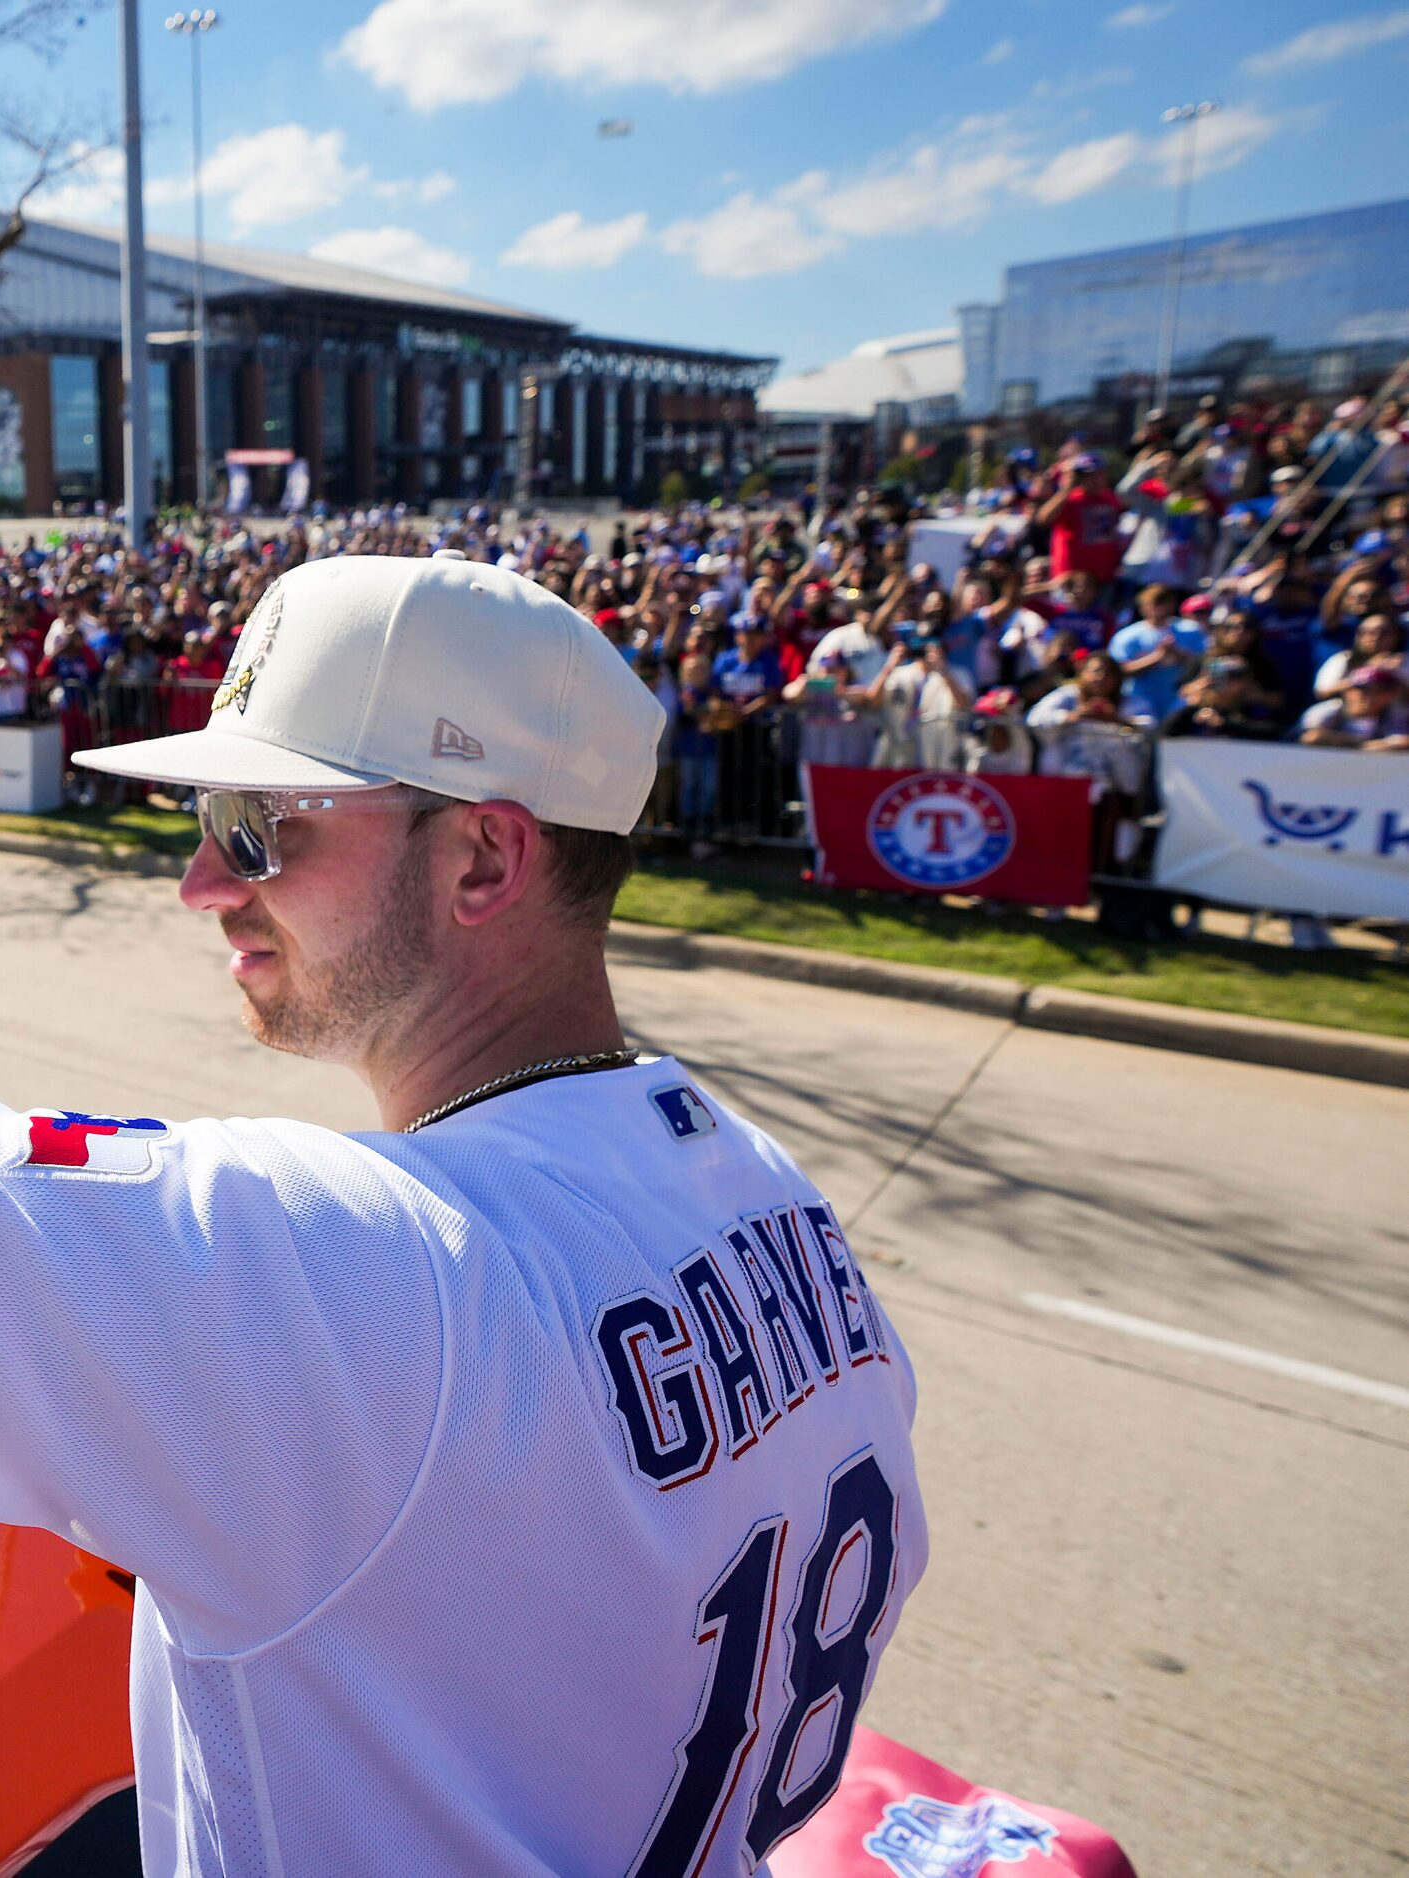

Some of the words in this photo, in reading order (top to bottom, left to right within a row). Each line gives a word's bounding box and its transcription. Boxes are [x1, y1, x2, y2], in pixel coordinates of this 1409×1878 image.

[914, 808, 967, 853] T
[589, 1201, 890, 1491] GARVE
[625, 1444, 900, 1878] 18
